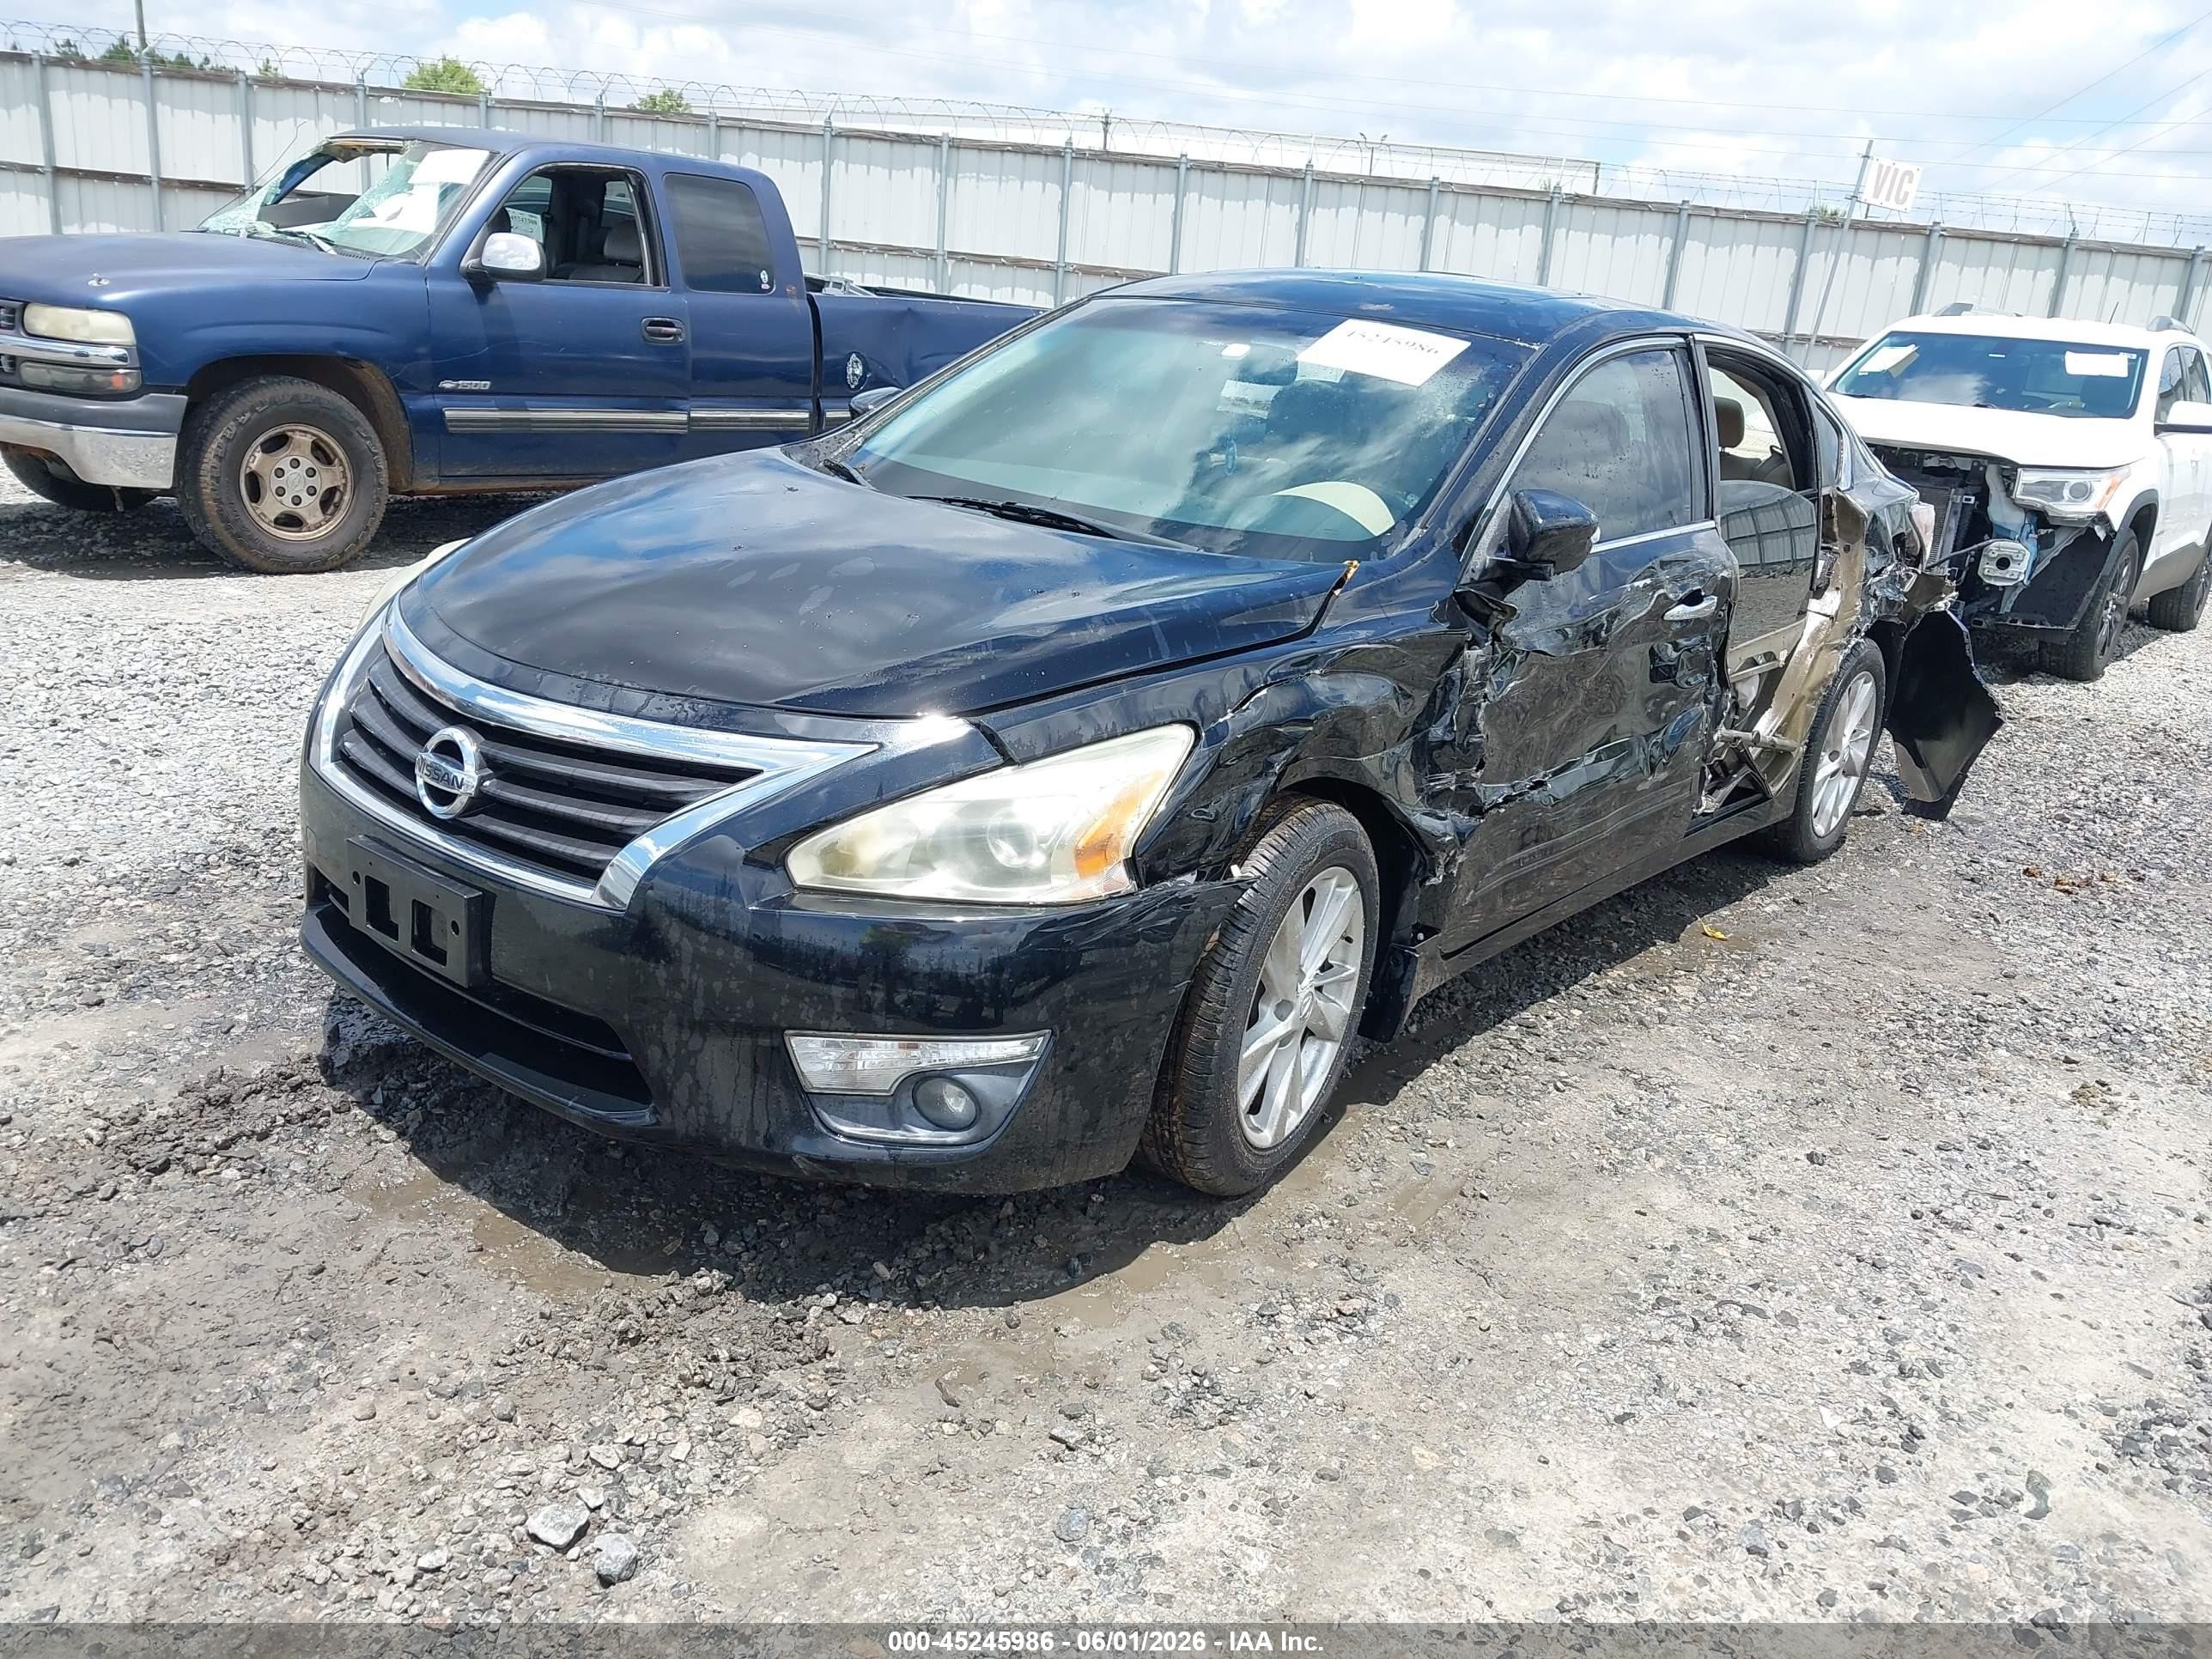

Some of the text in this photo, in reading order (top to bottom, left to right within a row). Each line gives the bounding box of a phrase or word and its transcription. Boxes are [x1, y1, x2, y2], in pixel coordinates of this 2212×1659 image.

[1873, 163, 1914, 205] VIC
[458, 380, 491, 390] 1500
[416, 756, 465, 790] NISSAN
